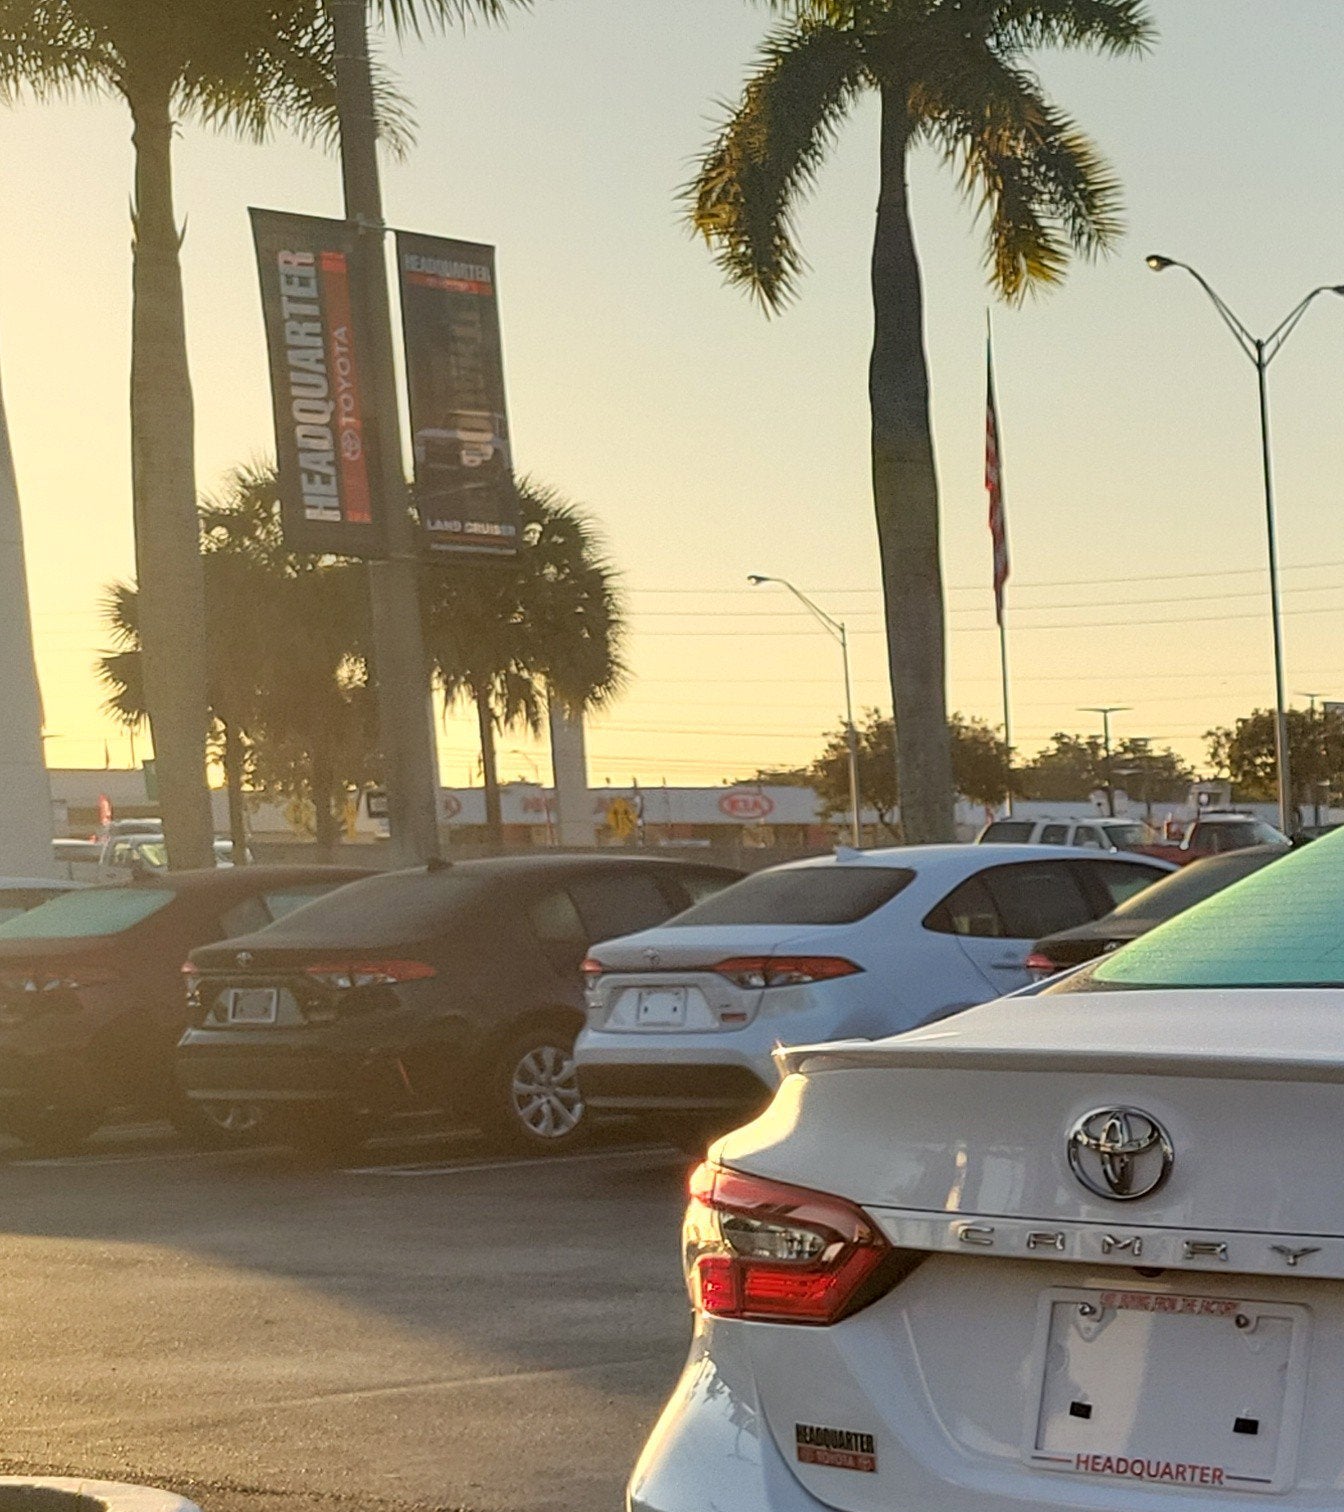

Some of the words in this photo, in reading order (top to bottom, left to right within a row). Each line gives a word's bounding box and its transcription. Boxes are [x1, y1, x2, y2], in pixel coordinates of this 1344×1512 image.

[404, 254, 491, 283] HEADQUARTER
[277, 251, 342, 522] HEADQUARTER
[333, 326, 357, 426] TOYOTA
[427, 519, 462, 532] LAND
[725, 795, 769, 816] KIA
[957, 1222, 1322, 1267] CAMRY
[796, 1424, 875, 1454] HEADQUARTER
[1076, 1453, 1225, 1486] HEADQUARTER
